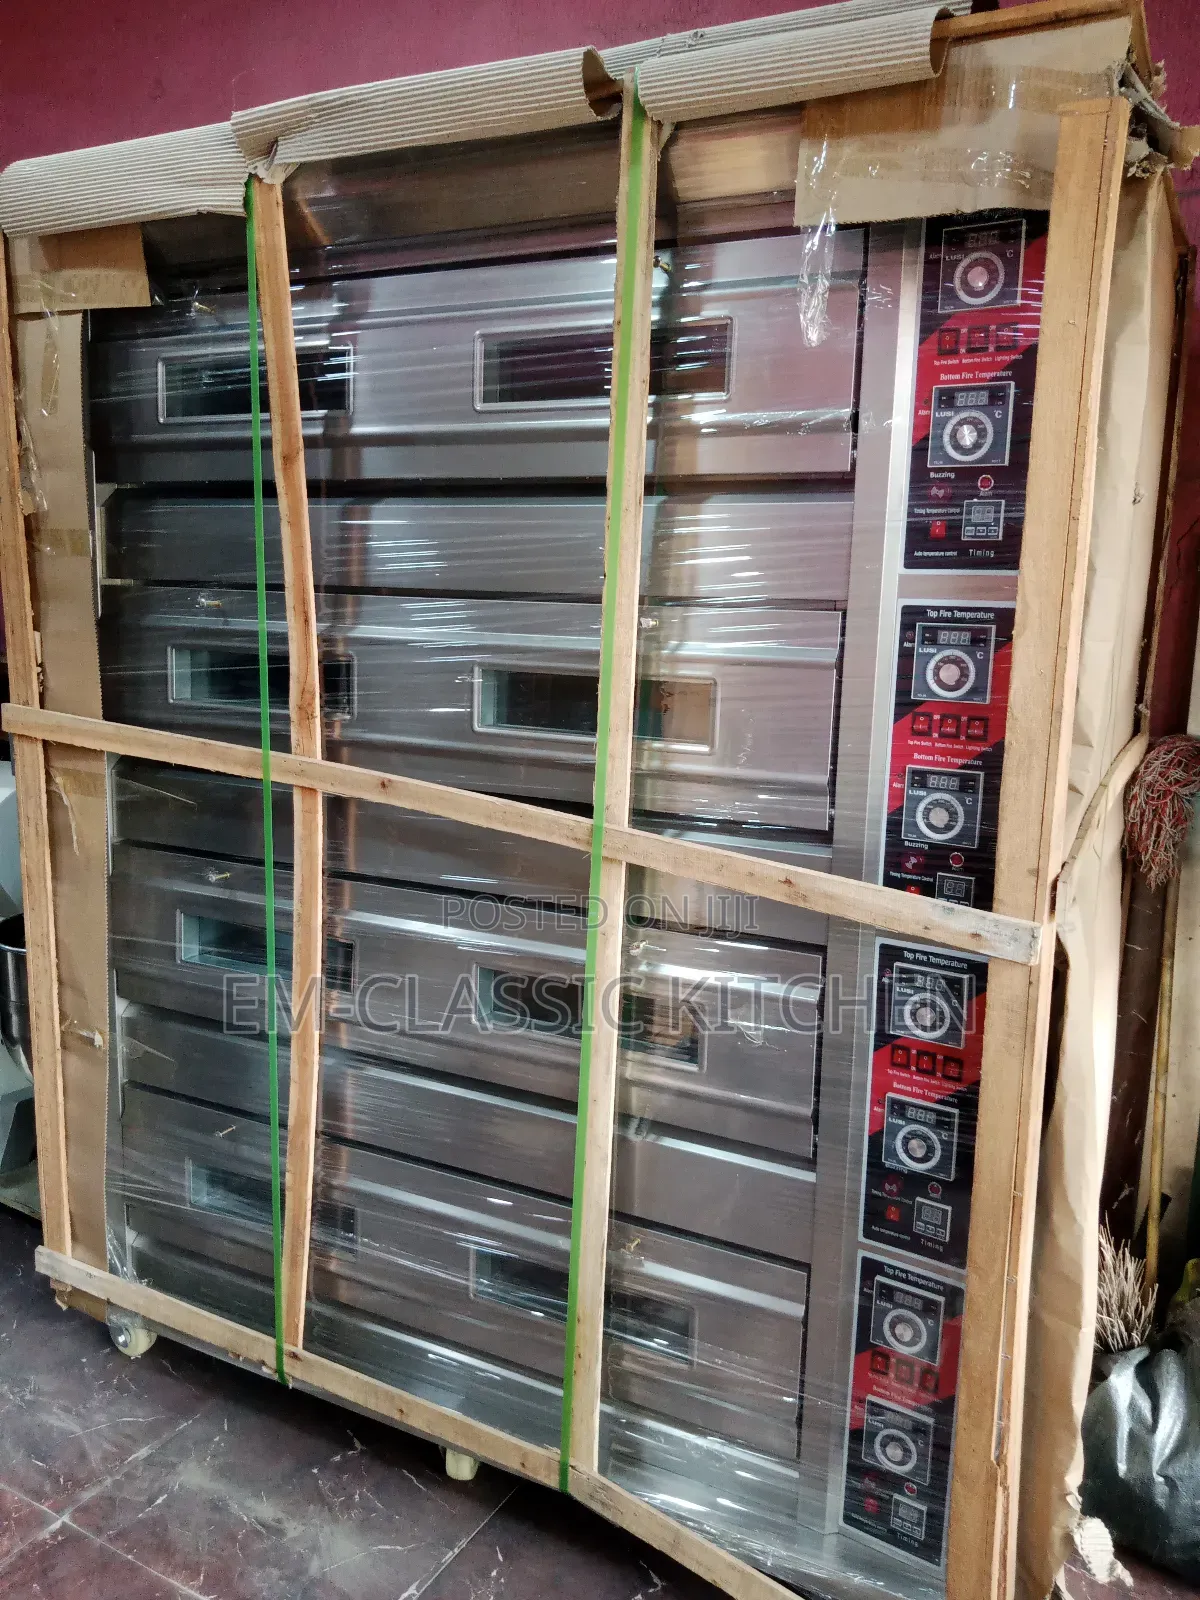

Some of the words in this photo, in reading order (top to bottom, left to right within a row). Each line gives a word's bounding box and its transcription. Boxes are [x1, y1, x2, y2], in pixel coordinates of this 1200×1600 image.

[975, 370, 1012, 379] Temperature
[969, 549, 995, 557] Timing
[927, 609, 938, 618] Top
[954, 610, 994, 619] Temperature
[947, 756, 982, 766] Temperature
[904, 841, 928, 849] Buzzing
[903, 951, 914, 960] Top
[916, 953, 927, 961] Fire
[929, 955, 967, 969] Temperature
[893, 1082, 912, 1092] Bottom
[913, 1086, 923, 1095] Fire
[925, 1089, 958, 1103] Temperature
[921, 1239, 943, 1252] Timing
[884, 1265, 893, 1275] Top
[895, 1269, 906, 1278] Fire
[908, 1272, 944, 1290] Temperature
